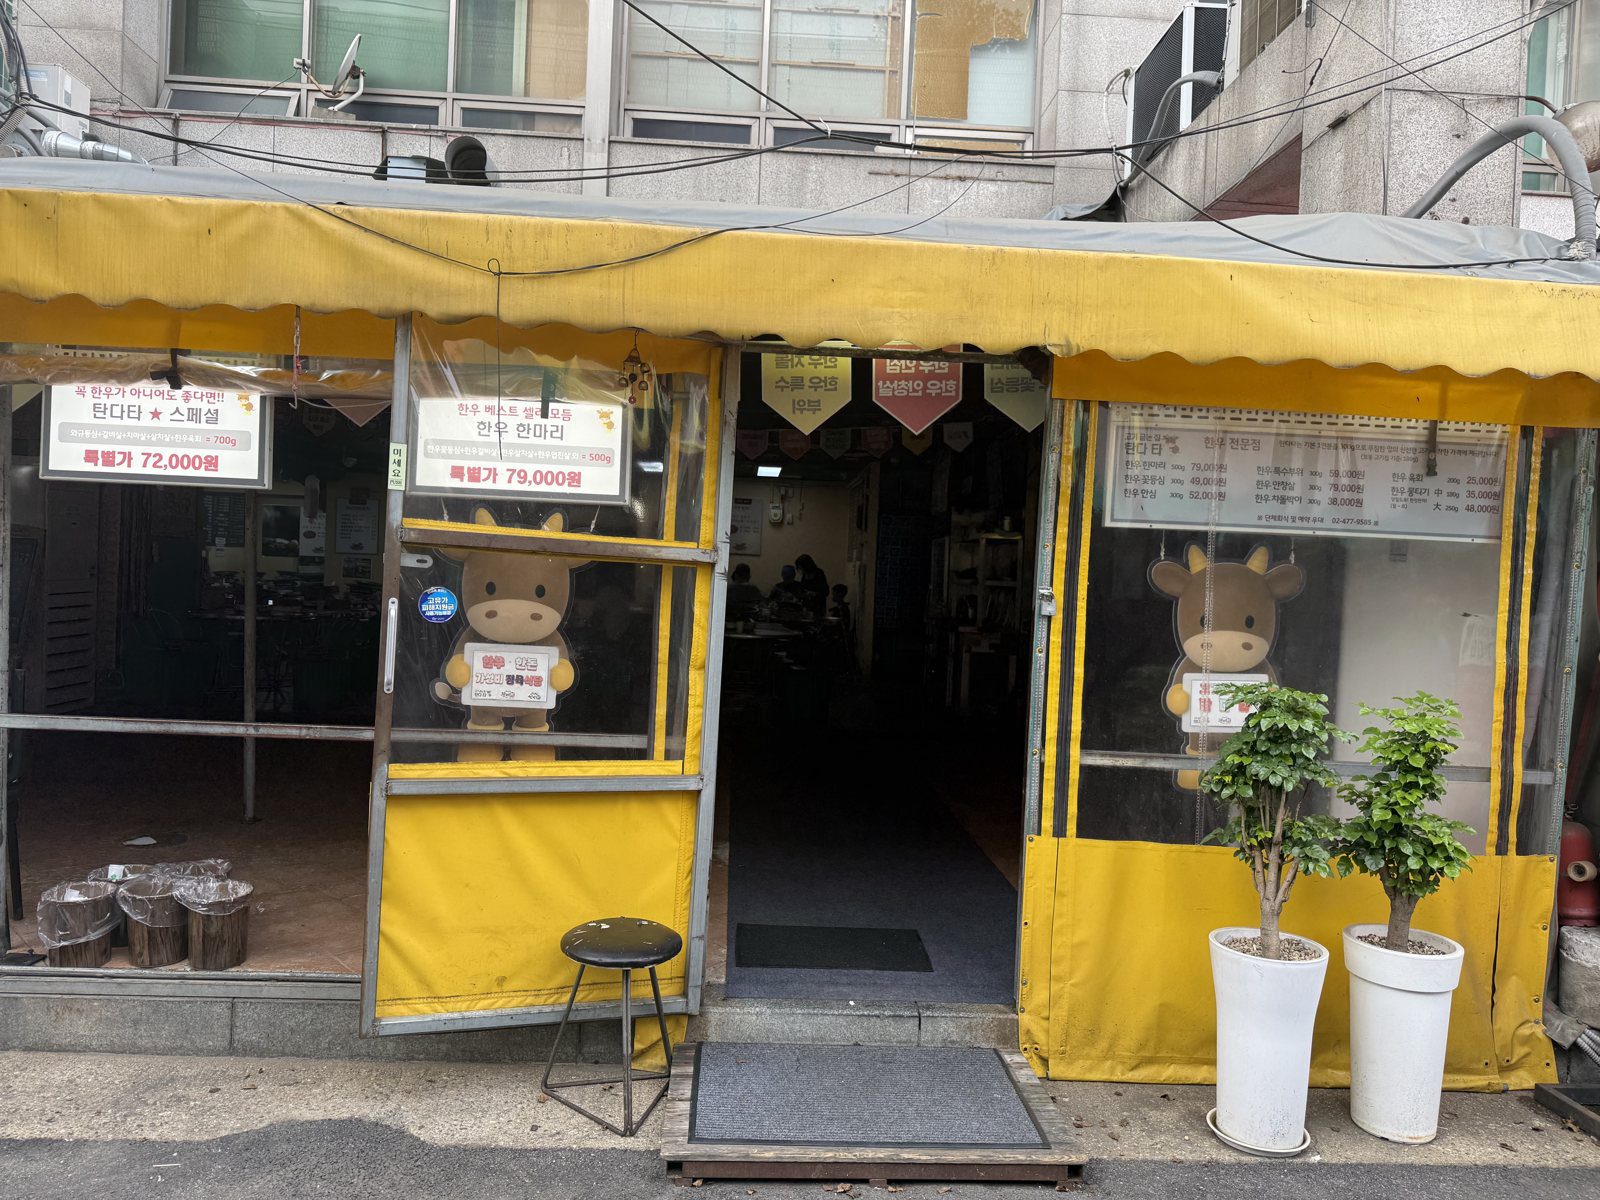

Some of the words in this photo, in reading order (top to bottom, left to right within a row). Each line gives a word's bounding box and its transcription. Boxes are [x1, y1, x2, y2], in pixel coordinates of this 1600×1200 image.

[74, 385, 87, 399] 꼭
[90, 386, 126, 400] 한우가
[129, 387, 178, 402] 아니어도
[181, 390, 225, 404] 좋다면!!
[92, 402, 143, 422] 탄다타
[169, 406, 221, 425] 스페셜
[457, 402, 481, 417] 한우
[484, 404, 520, 419] 베스트
[549, 408, 573, 422] 모듬
[476, 420, 509, 438] 한우
[516, 422, 565, 441] 한마리
[213, 436, 237, 448] 700g
[1125, 442, 1163, 456] 탄다타
[1204, 436, 1226, 449] 한우
[1228, 437, 1261, 451] 전문점
[83, 449, 134, 468] 특별가
[141, 452, 219, 472] 72,000원
[392, 448, 402, 477] 미세요
[588, 453, 612, 465] 500g
[1125, 460, 1141, 470] 한우
[1143, 461, 1166, 471] 한마리
[449, 465, 498, 484] 특별가
[505, 468, 582, 488] 79,000원
[1124, 474, 1141, 484] 한우
[1142, 475, 1165, 486] 꽃등심
[1256, 465, 1272, 476] 한우
[1273, 466, 1304, 477] 특수부위
[1329, 469, 1365, 480] 59,000원
[1391, 472, 1407, 482] 한우
[1408, 473, 1424, 483] 육회
[1123, 488, 1140, 499] 한우
[1141, 489, 1157, 499] 안심
[1255, 479, 1271, 490] 한우
[1272, 480, 1296, 491] 안창살
[1328, 483, 1365, 494] 79,000원
[1391, 486, 1406, 497] 한우
[1434, 488, 1443, 498] 中
[1465, 490, 1501, 501] 35,000원
[1254, 493, 1270, 504] 한우
[1271, 494, 1302, 505] 차돌박이
[1327, 497, 1364, 508] 38,000원
[1433, 502, 1442, 511] 大
[1464, 504, 1500, 515] 48,000원
[515, 656, 538, 671] 한돈
[475, 673, 503, 685] 가성비
